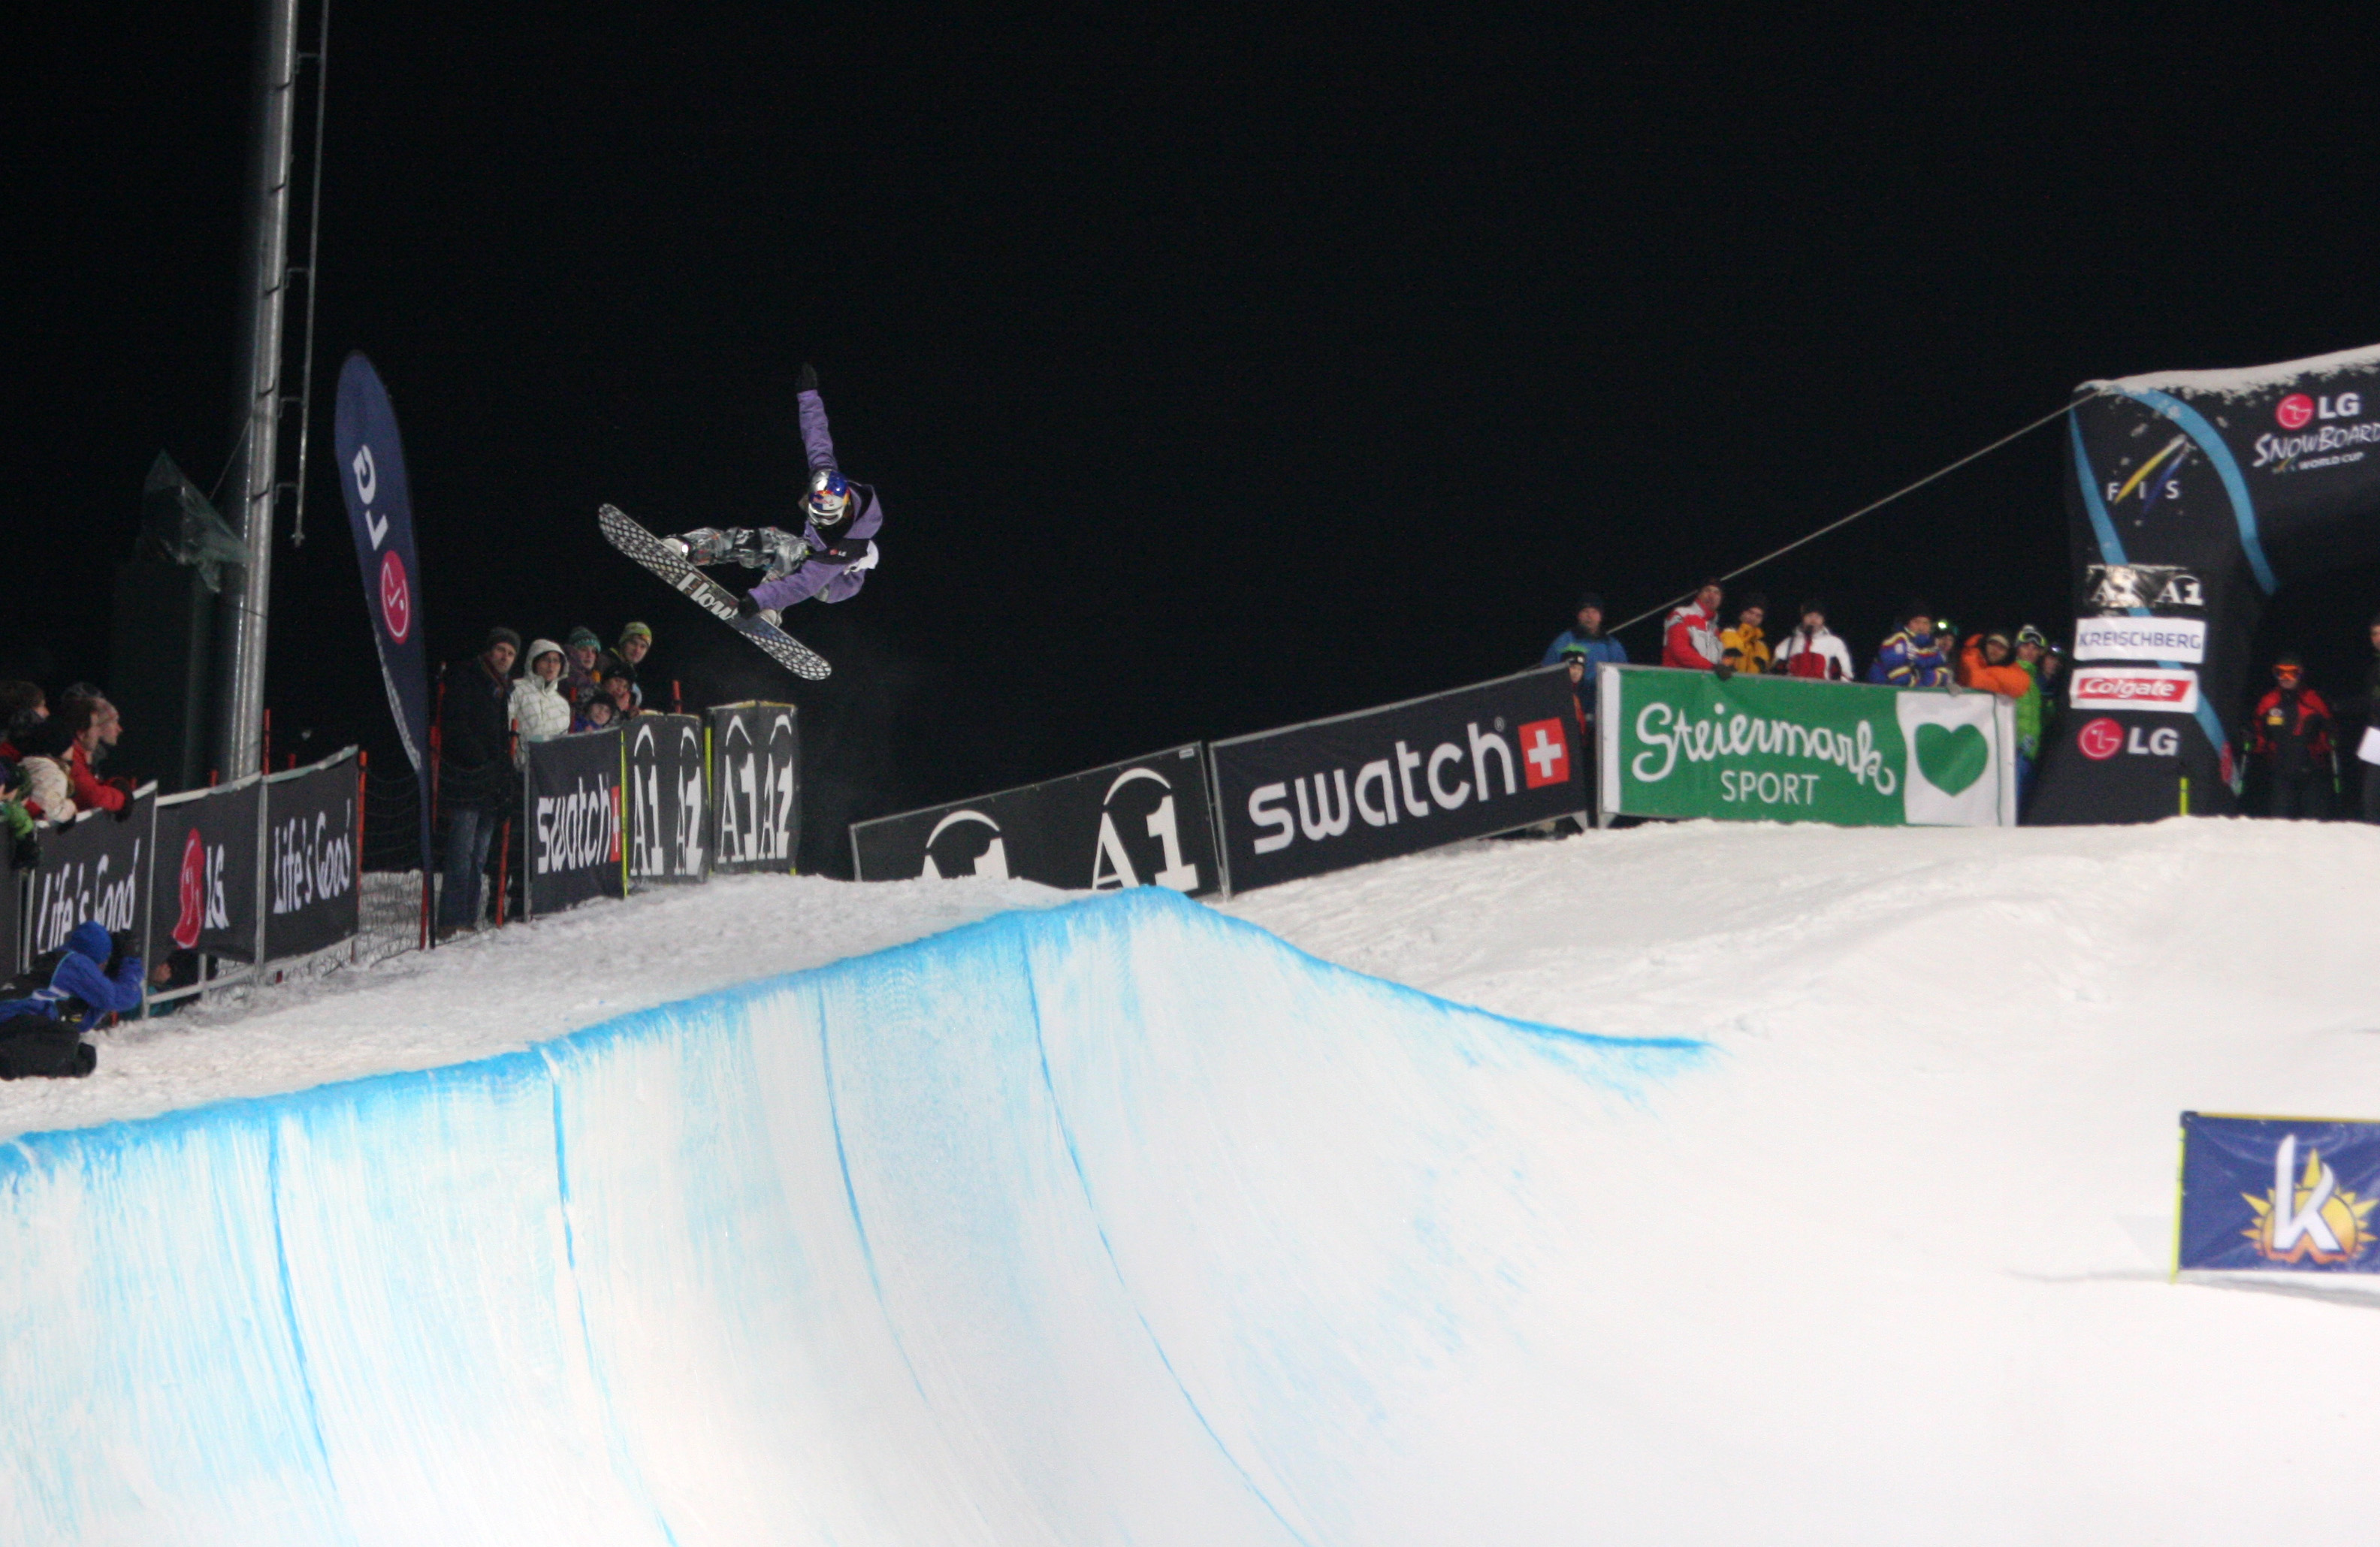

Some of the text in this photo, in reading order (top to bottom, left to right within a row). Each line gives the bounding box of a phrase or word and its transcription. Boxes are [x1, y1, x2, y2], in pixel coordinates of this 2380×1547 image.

[2318, 392, 2360, 419] LG
[353, 444, 388, 551] LG
[676, 572, 738, 621] Flow
[2154, 581, 2203, 606] A1
[2078, 631, 2201, 649] KREISCHBERG
[2085, 678, 2177, 698] Colgate
[1632, 702, 1895, 796] Steiermark
[2128, 727, 2178, 754] LG
[537, 773, 611, 874] swatch
[630, 764, 664, 875] A1
[1249, 722, 1516, 855] swatch
[1720, 771, 1820, 805] SPORT
[204, 844, 230, 929] LG
[316, 799, 351, 899] Good
[1092, 795, 1199, 893] A1
